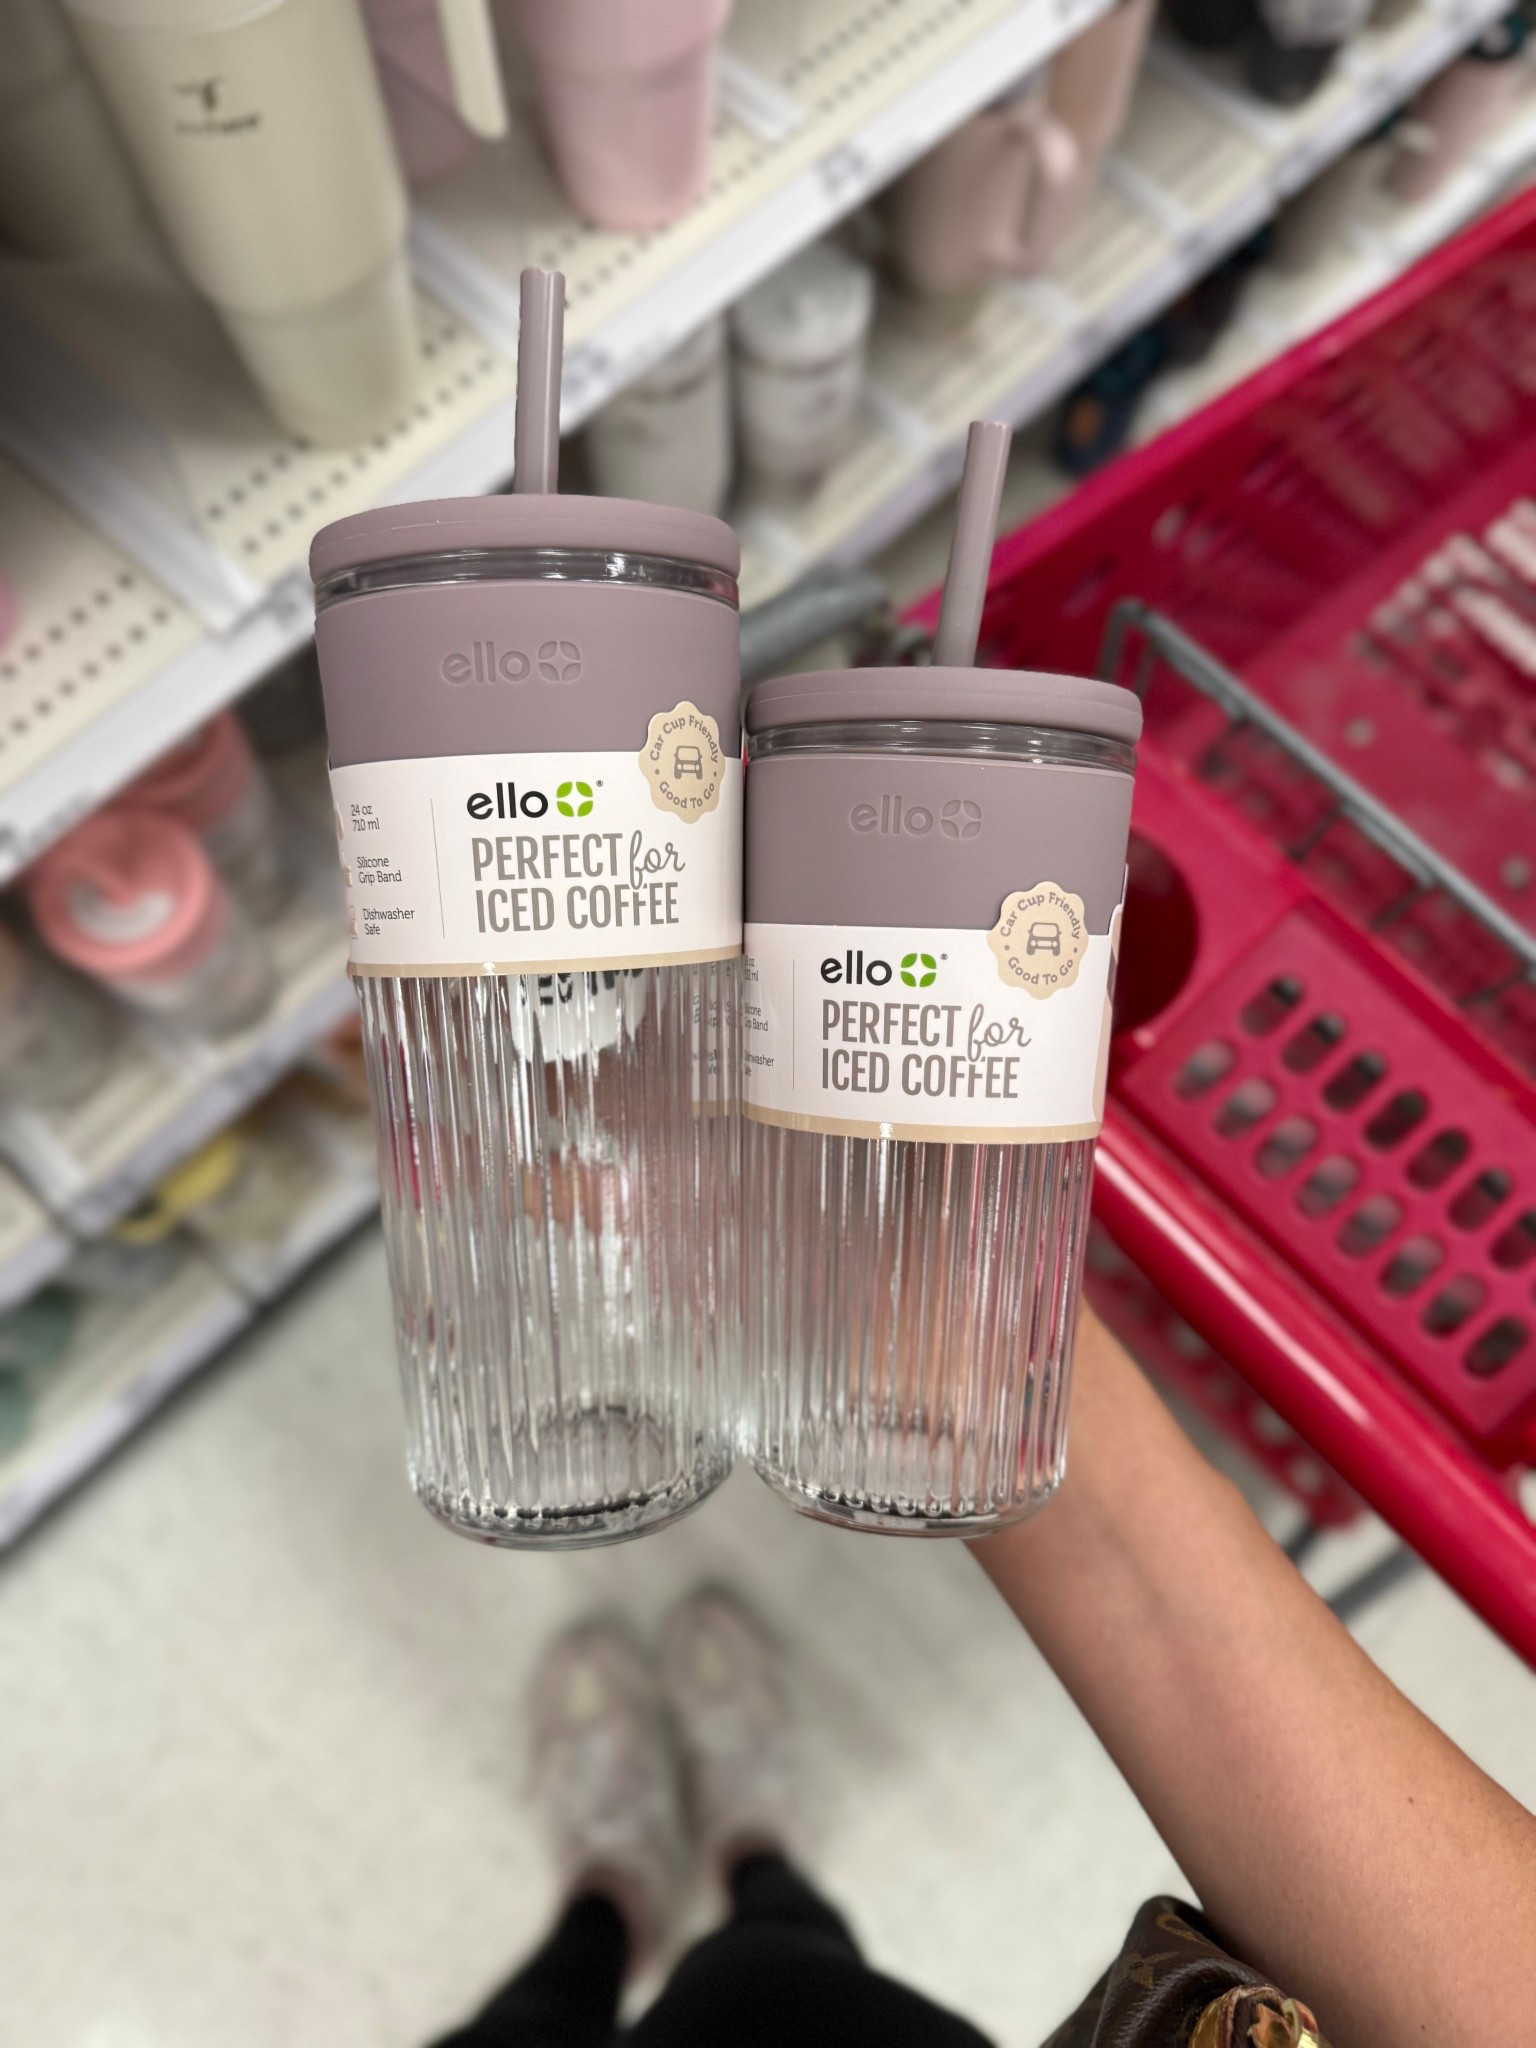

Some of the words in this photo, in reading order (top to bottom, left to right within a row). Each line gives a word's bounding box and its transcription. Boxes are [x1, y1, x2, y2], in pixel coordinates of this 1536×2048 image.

[441, 640, 532, 684] ello
[650, 735, 664, 761] Car
[663, 717, 686, 734] Cup
[689, 715, 719, 763] Friendly
[351, 804, 360, 816] 24
[362, 805, 373, 815] oz
[467, 782, 549, 820] ello
[660, 781, 687, 808] Good
[690, 798, 703, 809] To
[703, 783, 715, 800] Go
[353, 819, 366, 831] 710
[368, 818, 380, 830] ml
[849, 794, 934, 837] ello
[357, 856, 390, 868] Silicone
[359, 871, 375, 885] Grip
[377, 870, 402, 883] Band
[471, 833, 623, 881] PERFECT
[629, 830, 686, 890] for
[363, 908, 415, 920] Dishwasher
[475, 887, 555, 933] ICED
[566, 882, 680, 930] COFFEE
[1000, 911, 1018, 937] Car
[1017, 894, 1044, 911] Cup
[1048, 892, 1081, 940] Friendly
[365, 923, 381, 935] Safe
[820, 950, 893, 986] ello
[1008, 957, 1040, 985] Good
[1042, 973, 1058, 985] To
[1059, 960, 1074, 976] Go
[753, 1018, 769, 1032] Band
[822, 999, 962, 1048] PERFECT
[967, 1003, 1032, 1062] for
[822, 1048, 890, 1093] ICED
[901, 1053, 1021, 1099] COFFEE
